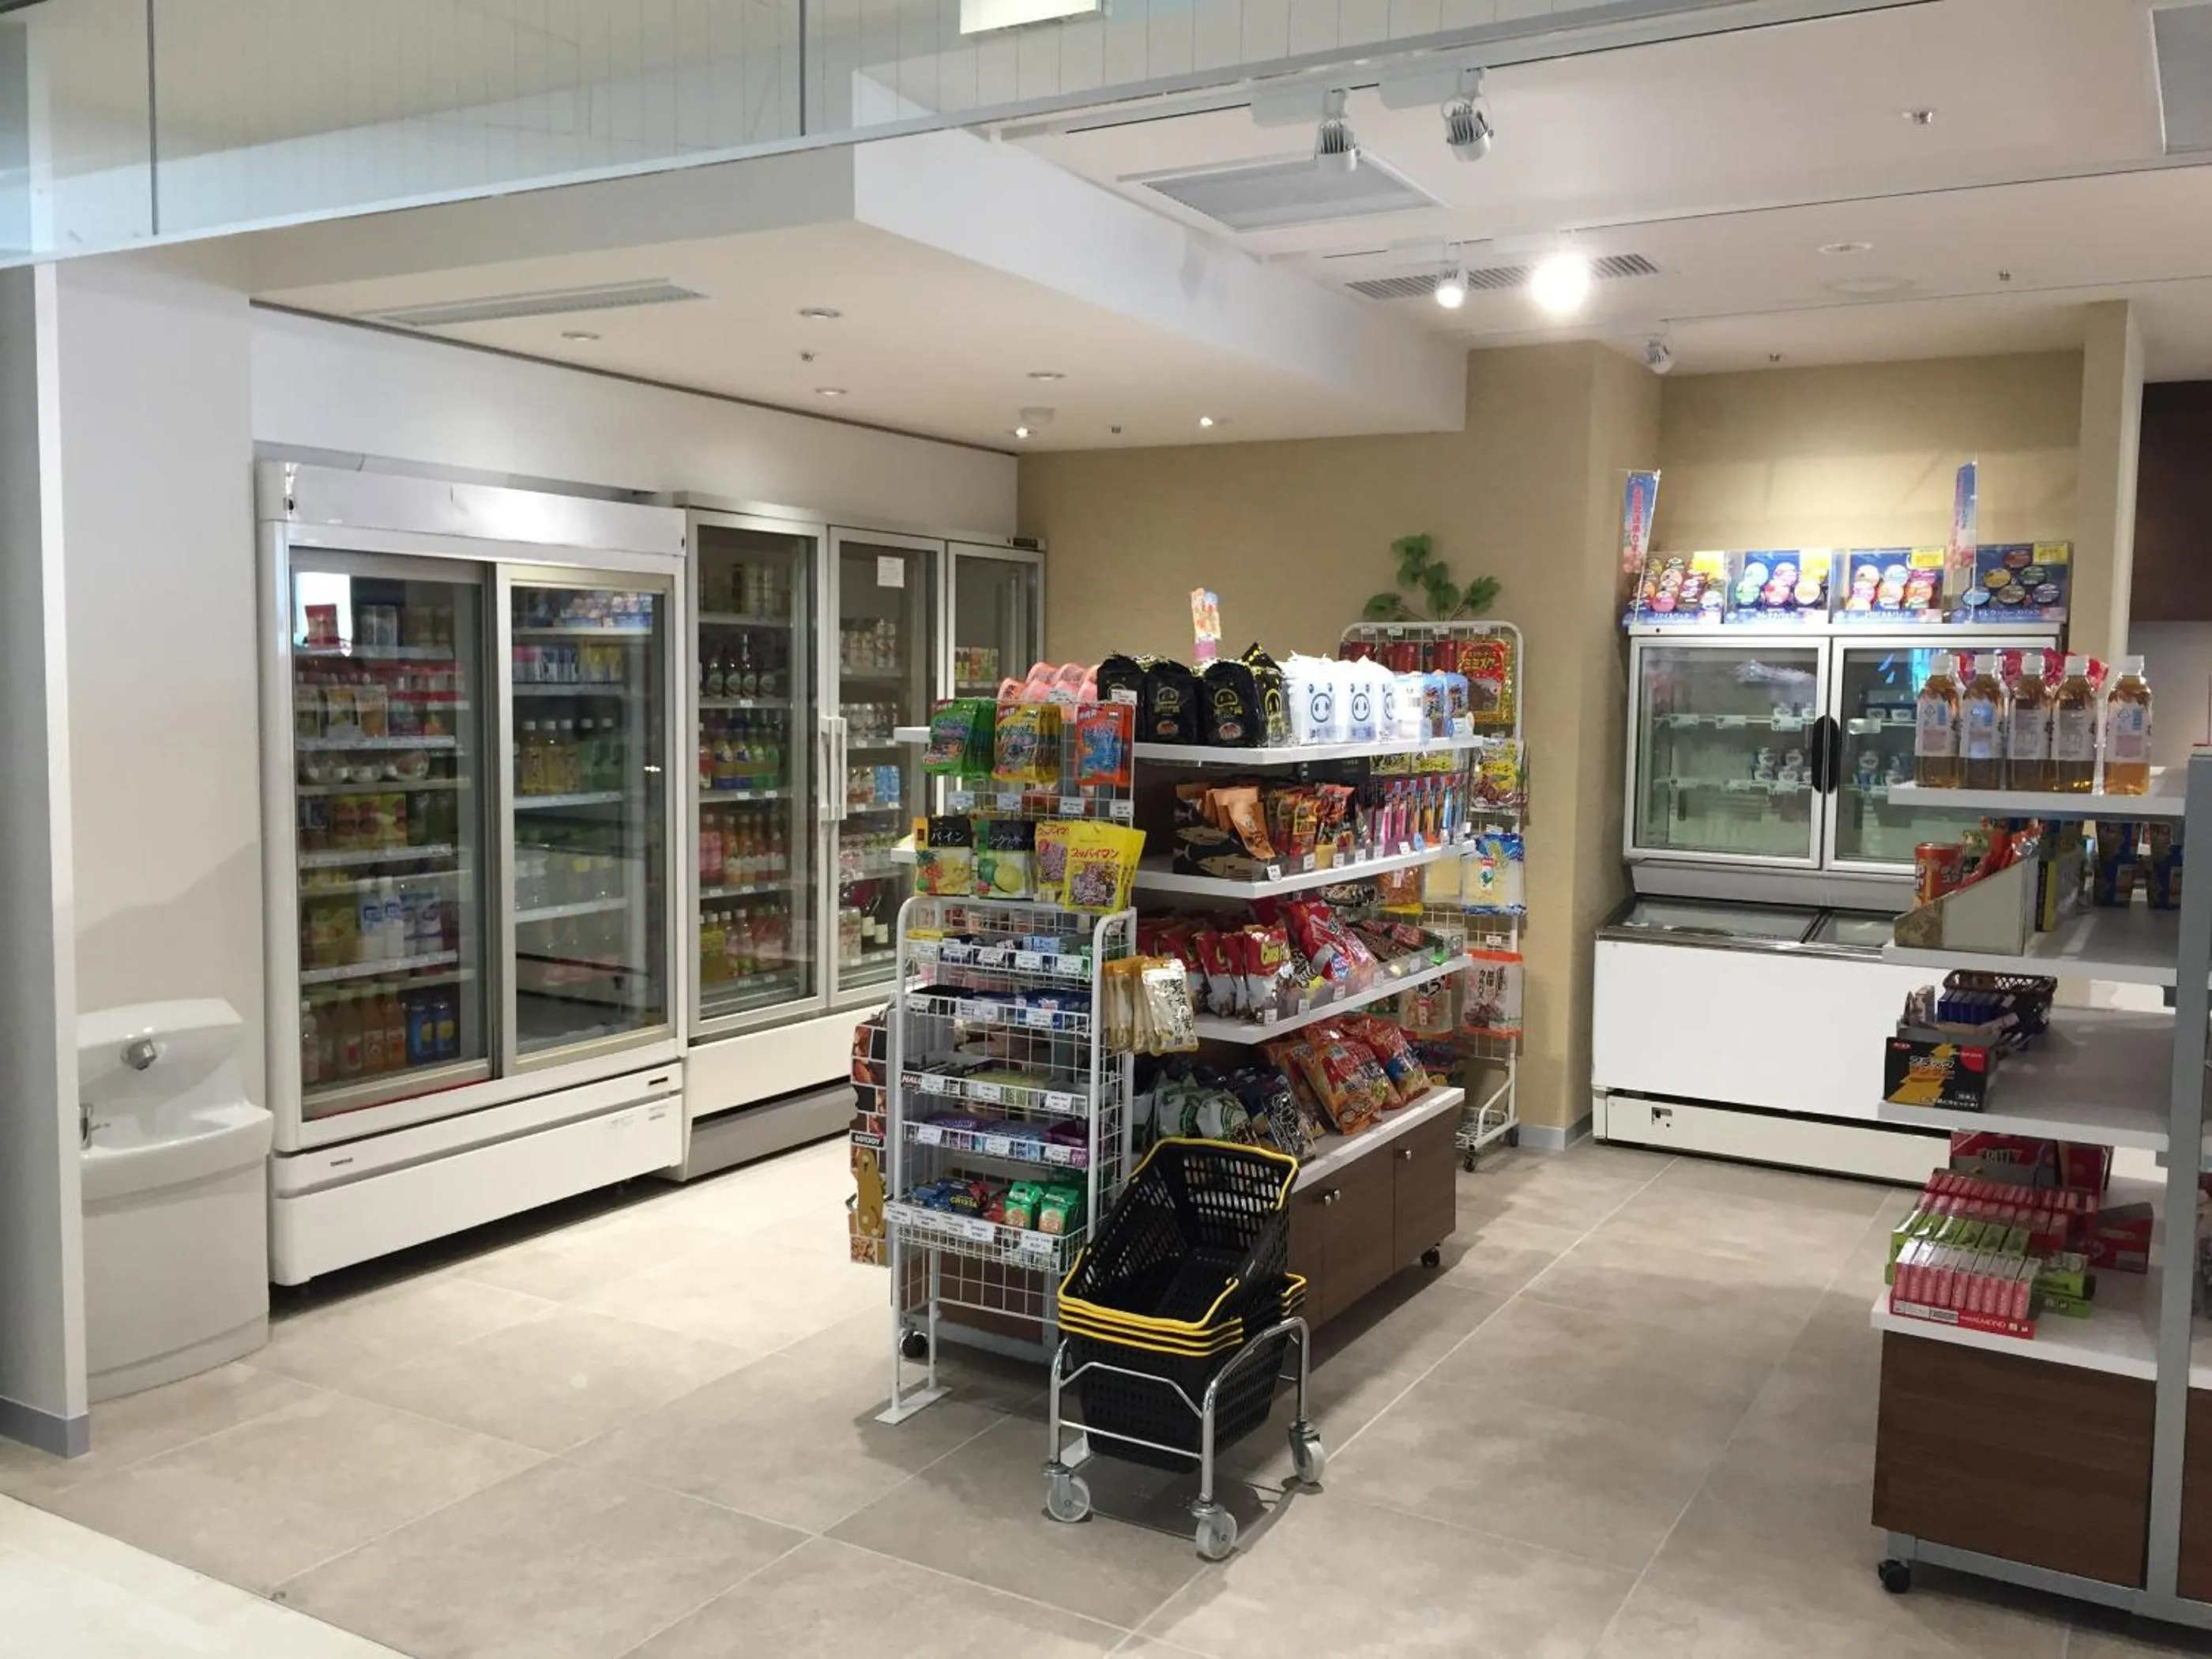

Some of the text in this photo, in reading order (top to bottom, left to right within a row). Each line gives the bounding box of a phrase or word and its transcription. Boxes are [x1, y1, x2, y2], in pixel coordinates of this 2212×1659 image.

[931, 830, 964, 841] パイン
[1071, 848, 1119, 859] スッパイマン
[855, 1134, 881, 1145] SOYJOY
